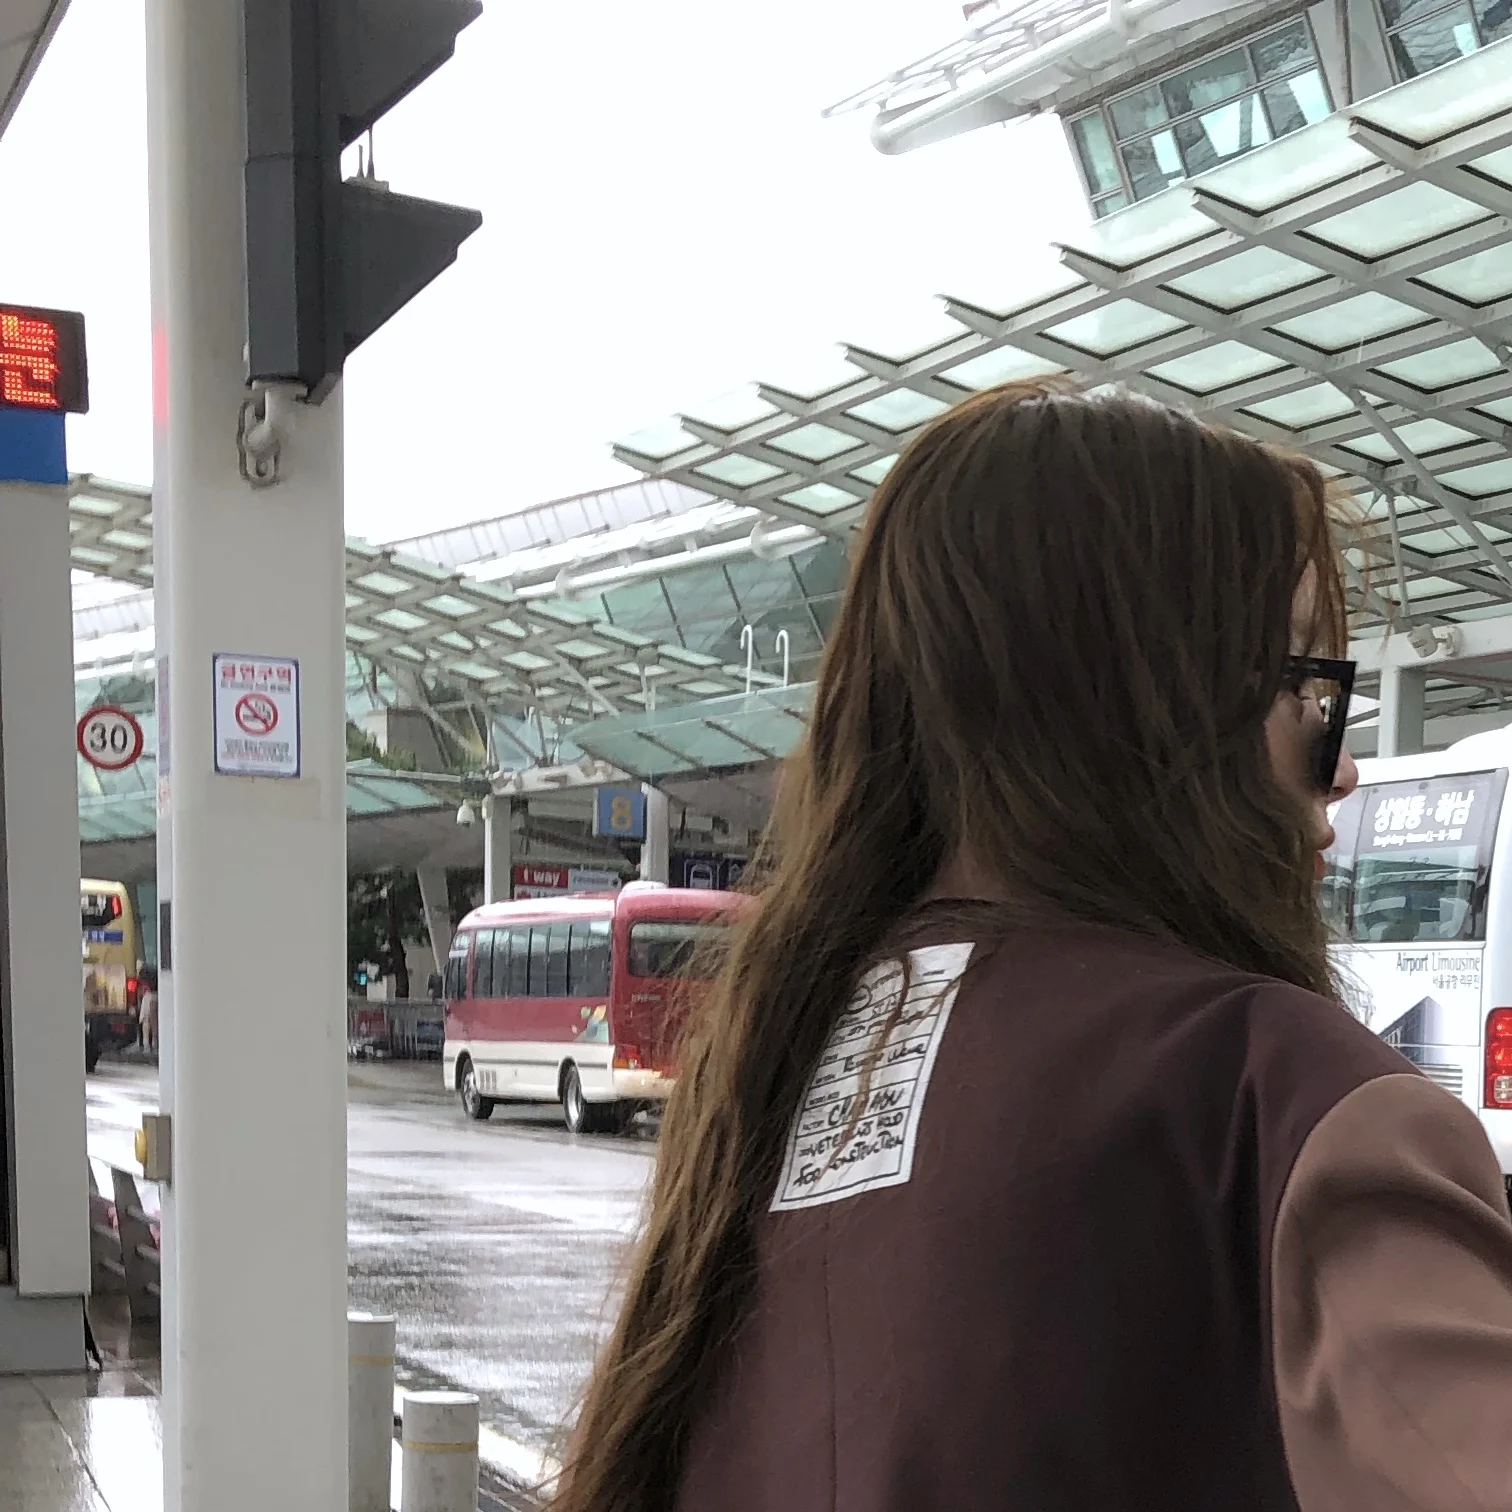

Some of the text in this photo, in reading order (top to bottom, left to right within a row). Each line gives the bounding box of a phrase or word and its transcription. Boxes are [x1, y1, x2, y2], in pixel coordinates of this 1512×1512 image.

[89, 722, 128, 754] 30
[611, 796, 632, 830] 8
[1396, 952, 1480, 976] Airport Limousine
